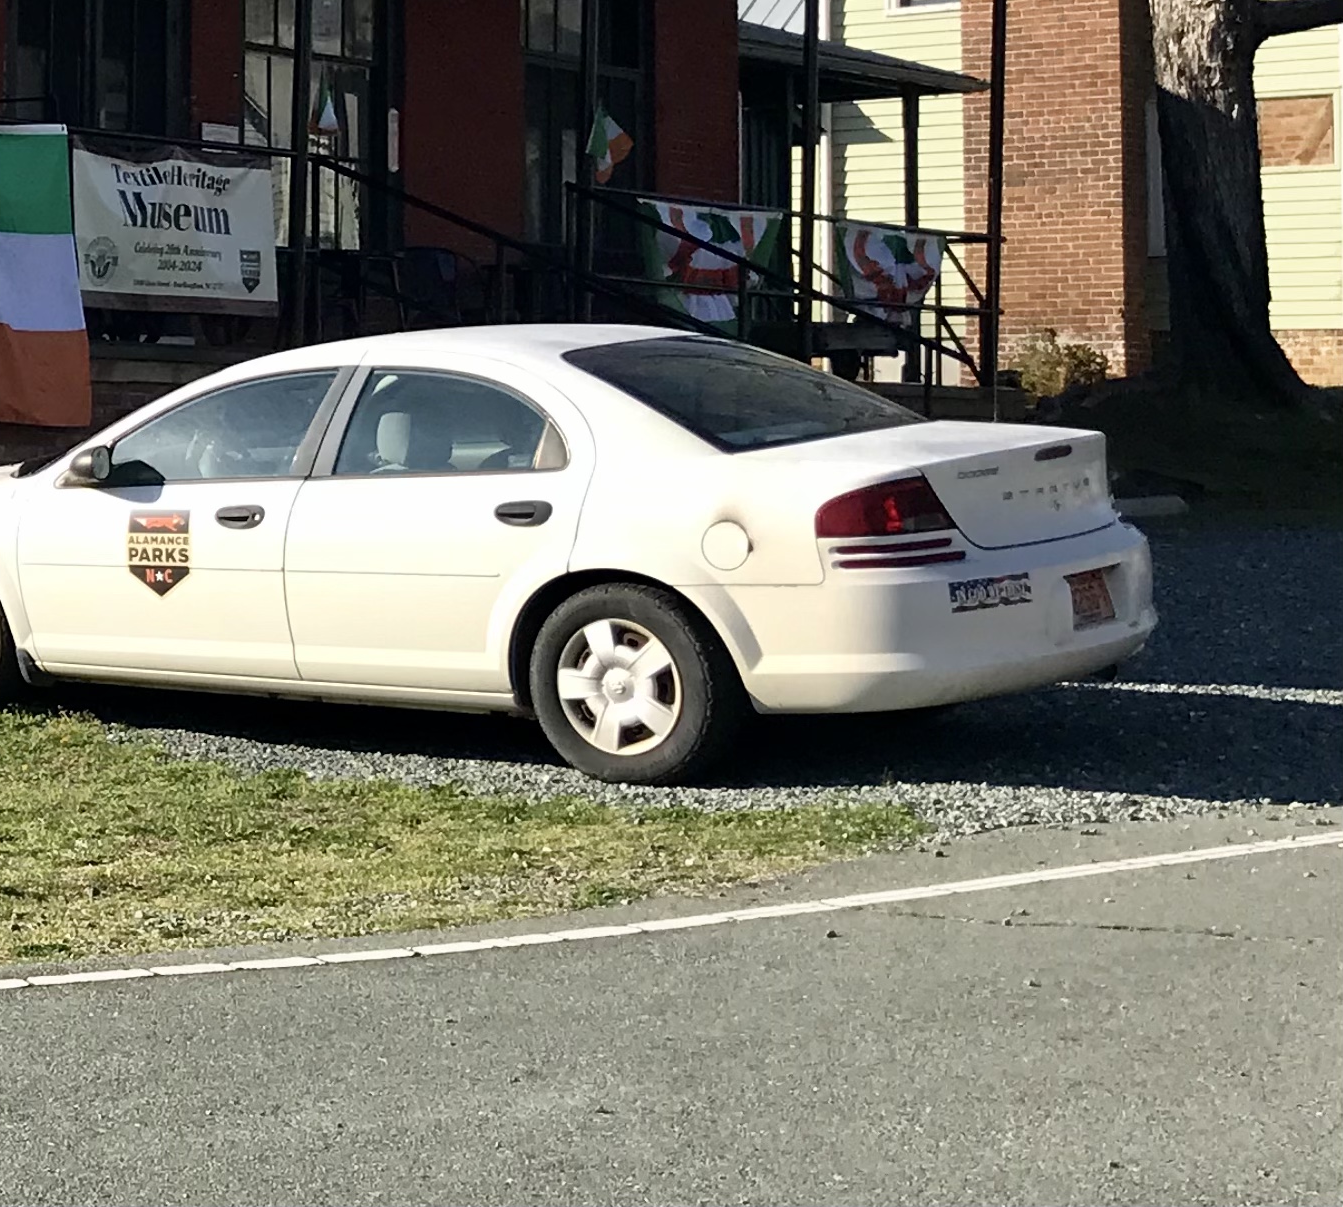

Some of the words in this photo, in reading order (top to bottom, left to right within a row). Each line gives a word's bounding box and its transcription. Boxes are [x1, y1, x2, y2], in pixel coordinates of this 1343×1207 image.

[111, 163, 171, 187] Textile
[171, 165, 231, 197] Heritage
[117, 189, 232, 236] Museum
[128, 535, 189, 545] ALAMANCE
[128, 547, 189, 563] PARKS
